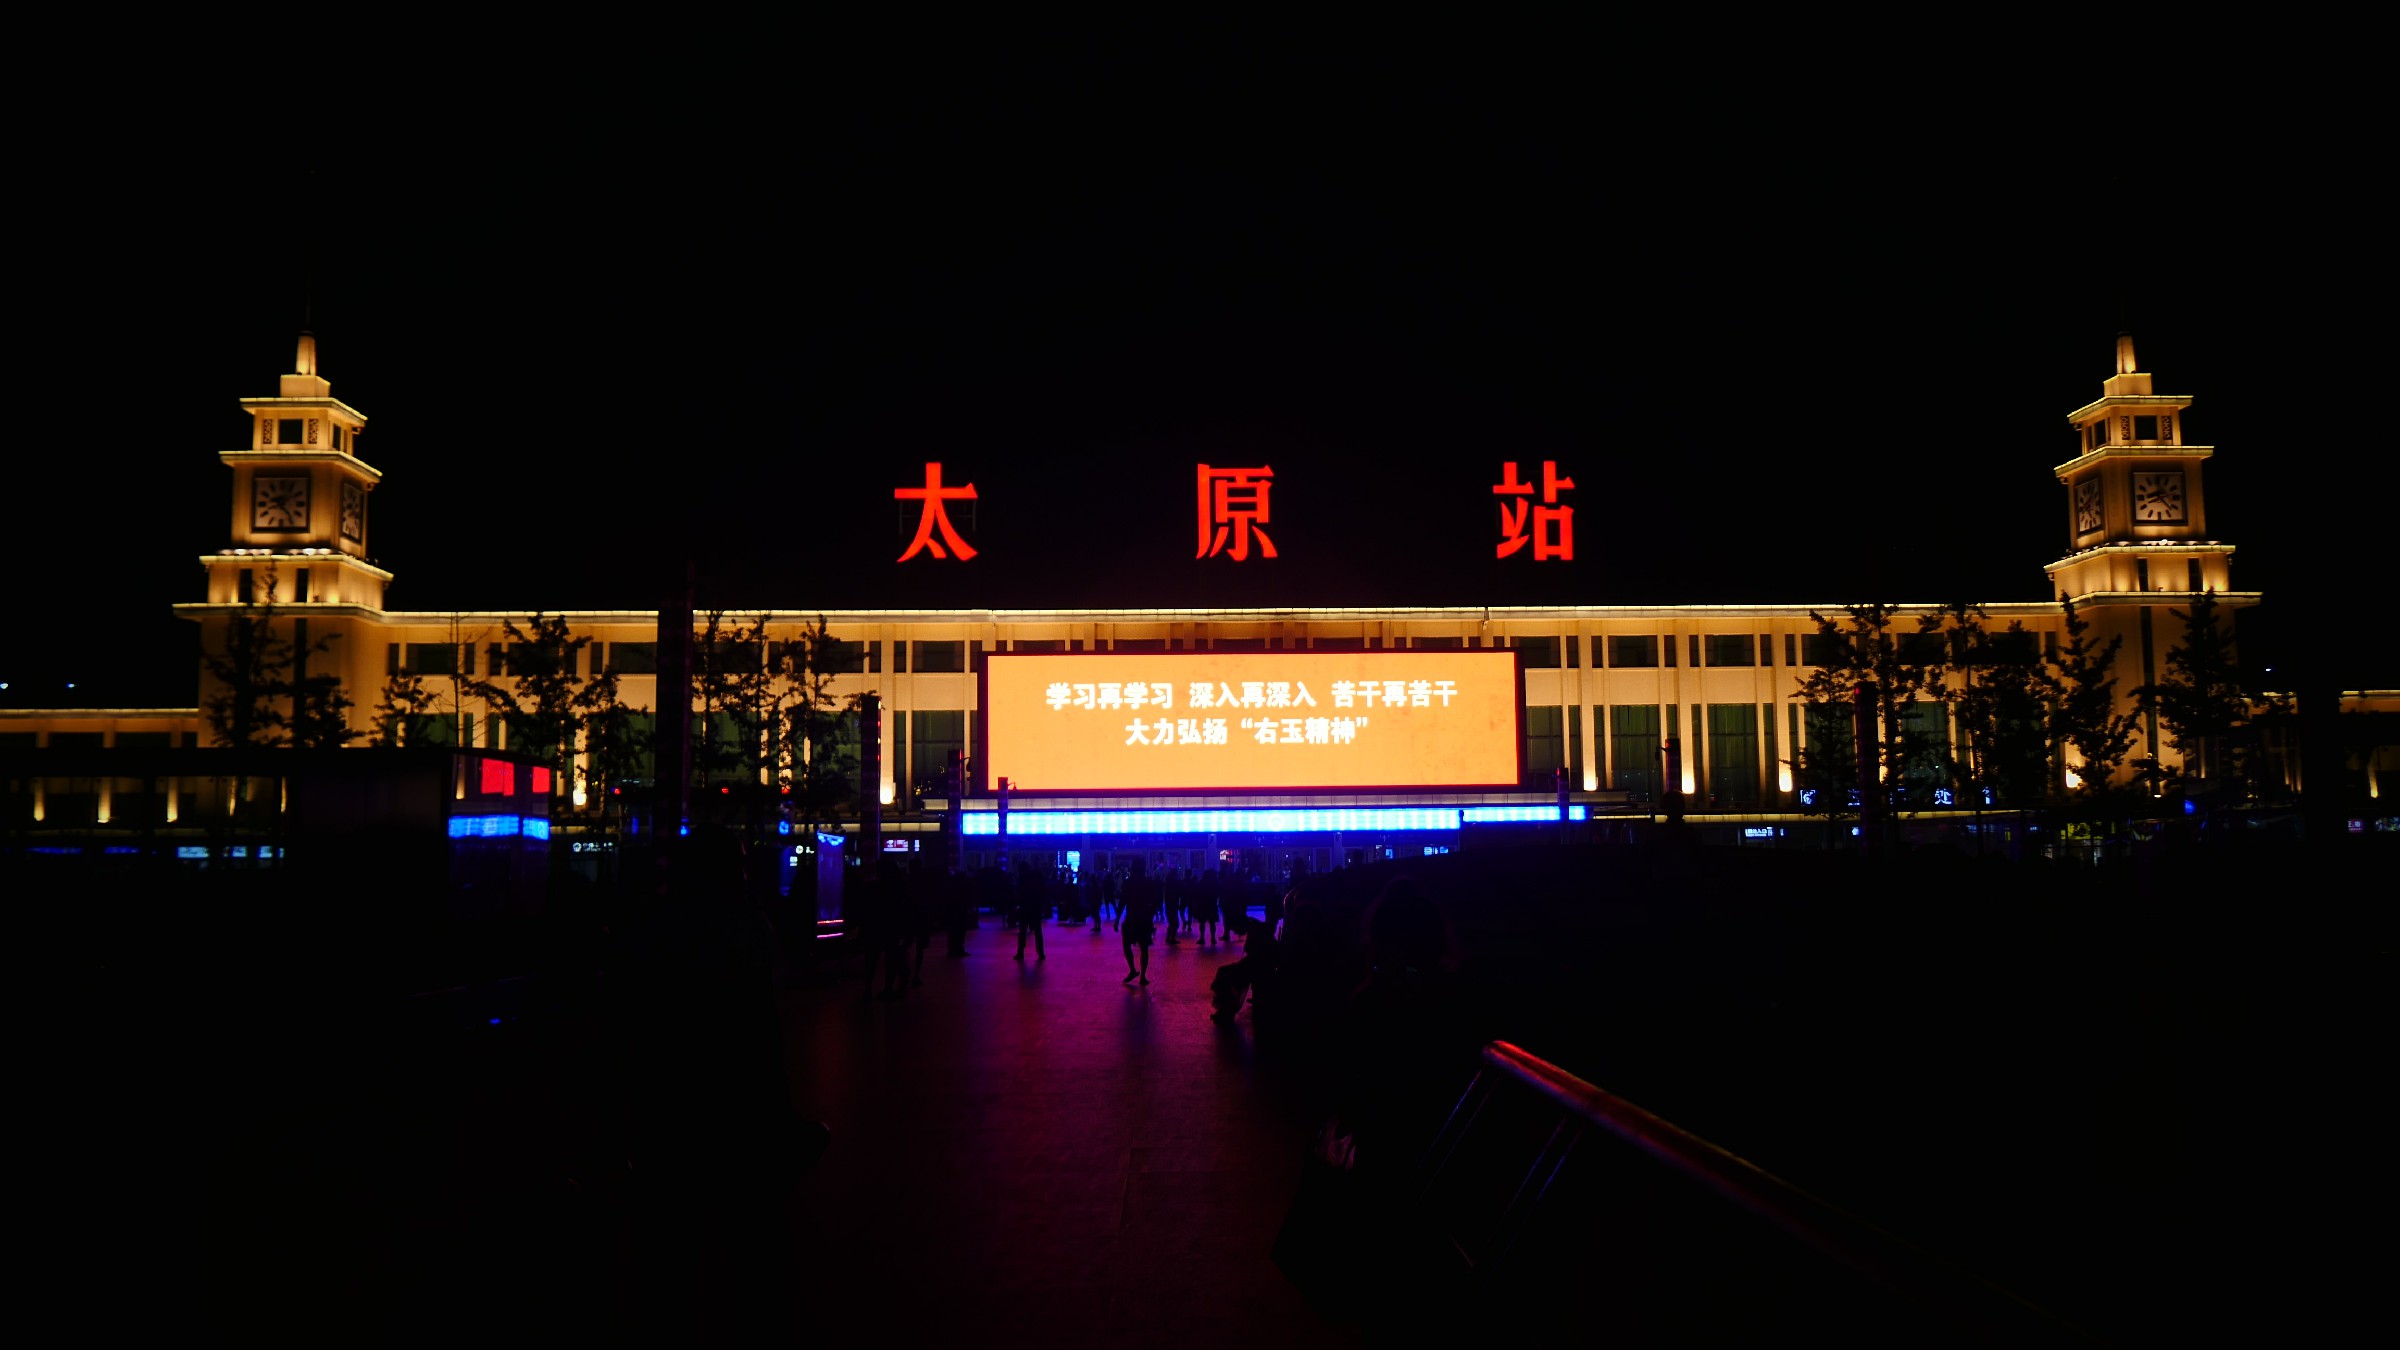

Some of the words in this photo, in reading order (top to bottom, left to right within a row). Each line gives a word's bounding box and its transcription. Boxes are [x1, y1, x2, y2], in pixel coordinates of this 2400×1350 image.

[894, 460, 1575, 563] 太原站
[1045, 682, 1173, 711] 学习再学习
[1188, 681, 1317, 709] 深入再深入
[1330, 679, 1458, 708] 苦干再苦干
